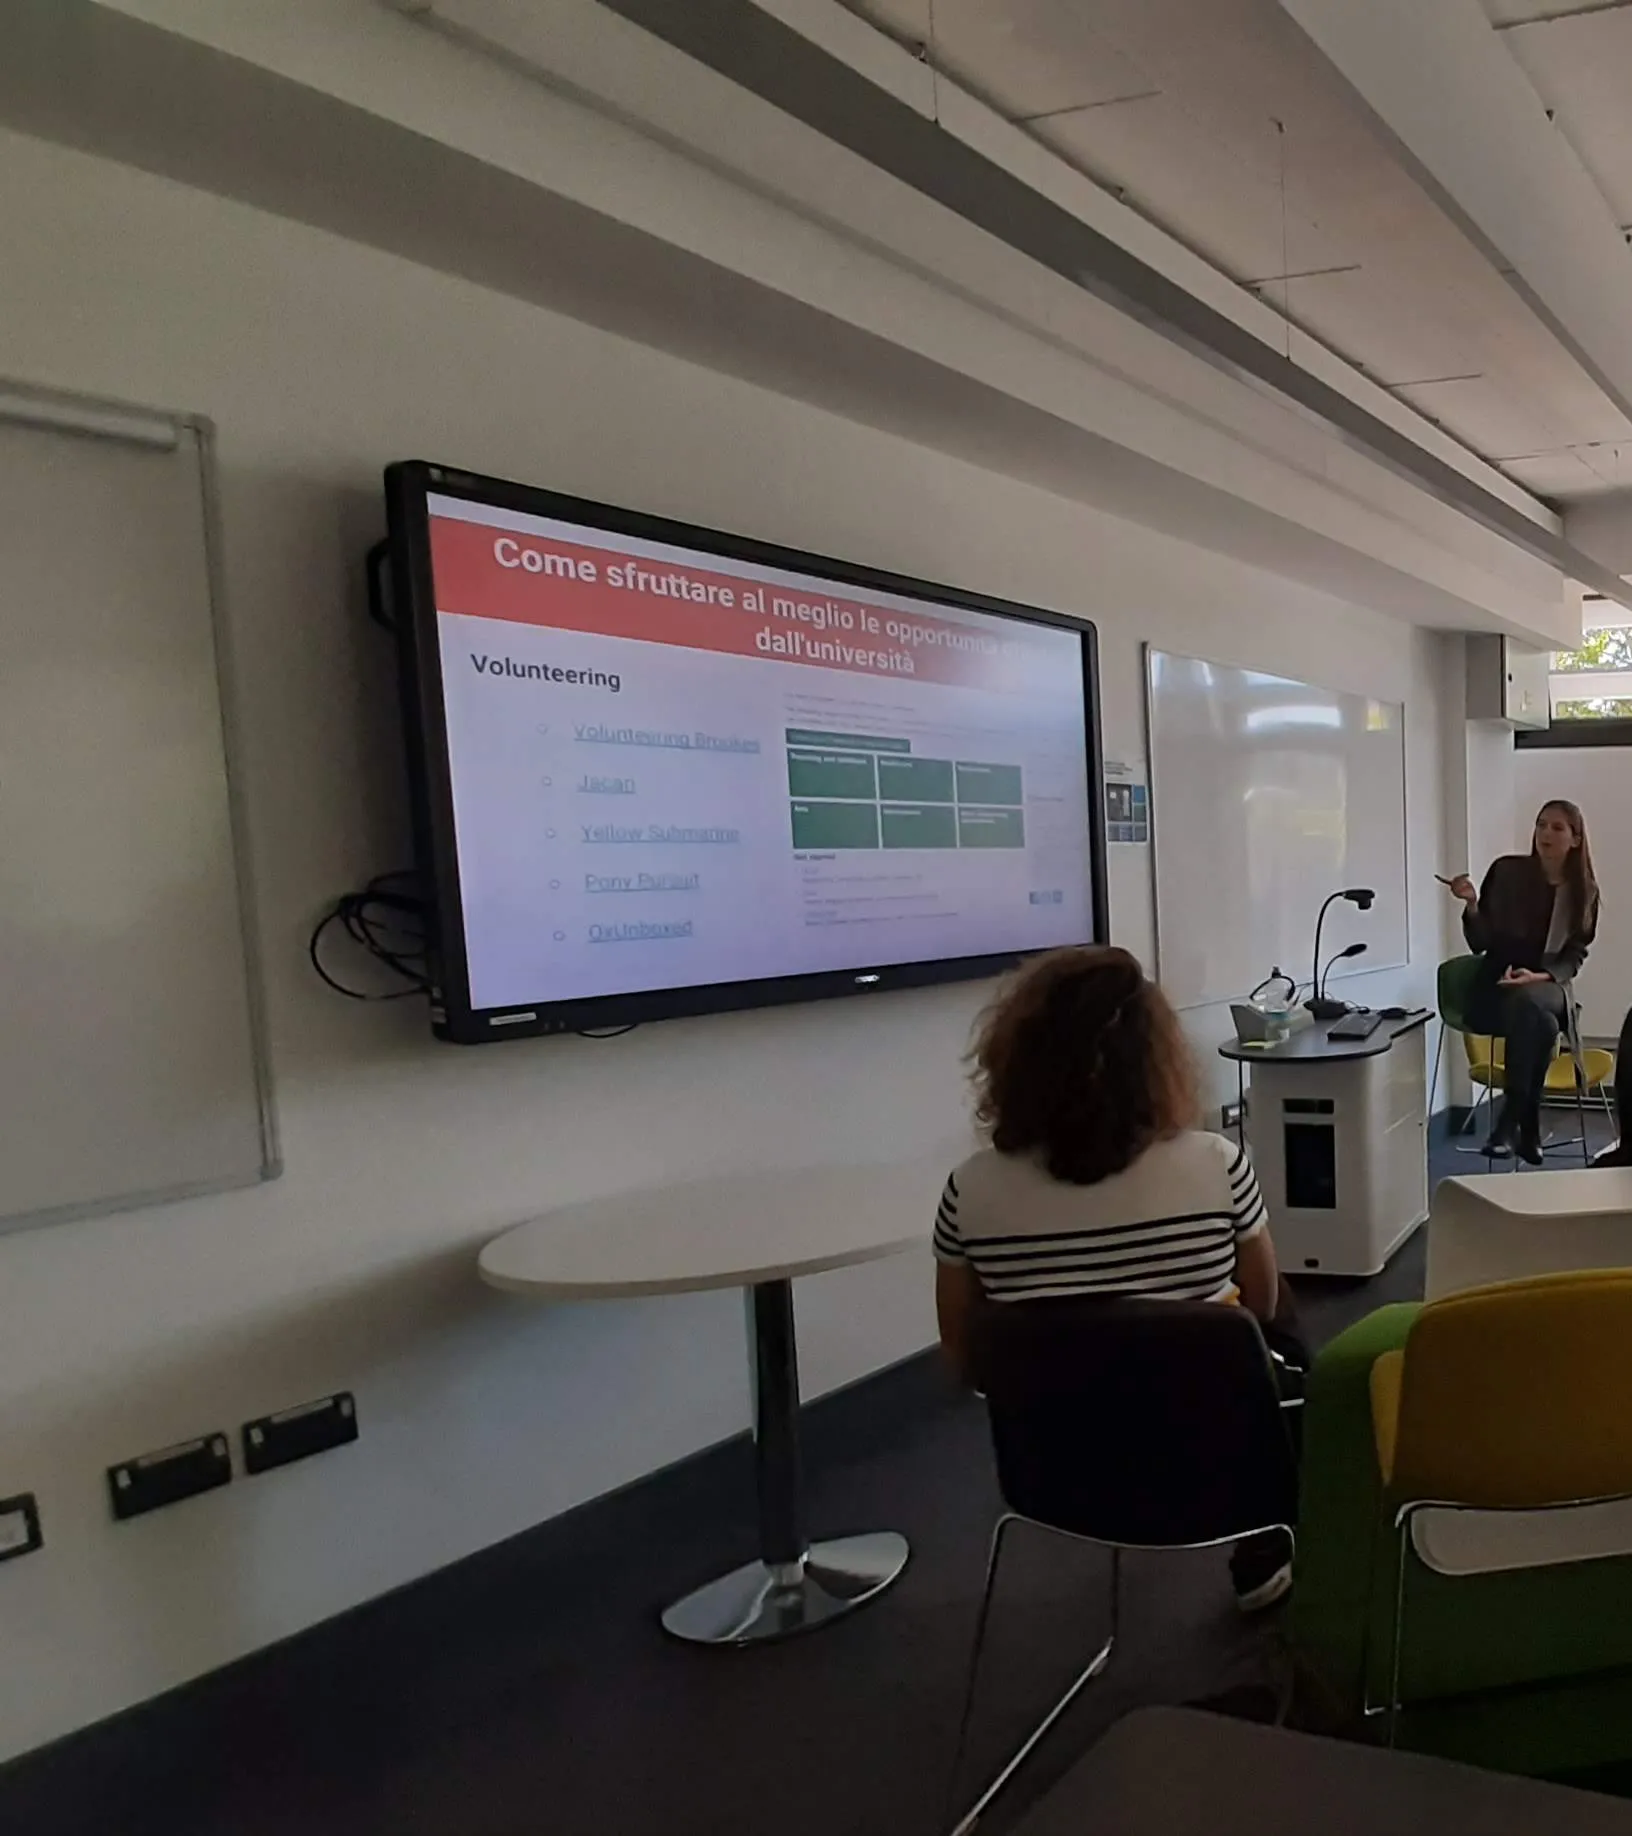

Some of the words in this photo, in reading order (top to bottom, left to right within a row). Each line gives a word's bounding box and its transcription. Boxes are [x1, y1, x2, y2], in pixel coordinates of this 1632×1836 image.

[494, 538, 597, 582] Come
[606, 562, 734, 607] sfruttare
[742, 588, 765, 614] al
[773, 594, 854, 630] meglio
[861, 609, 880, 634] le
[755, 627, 915, 673] dall'università
[470, 654, 621, 692] Volunteering
[573, 722, 690, 749] Volunteering
[581, 823, 643, 843] Yellow
